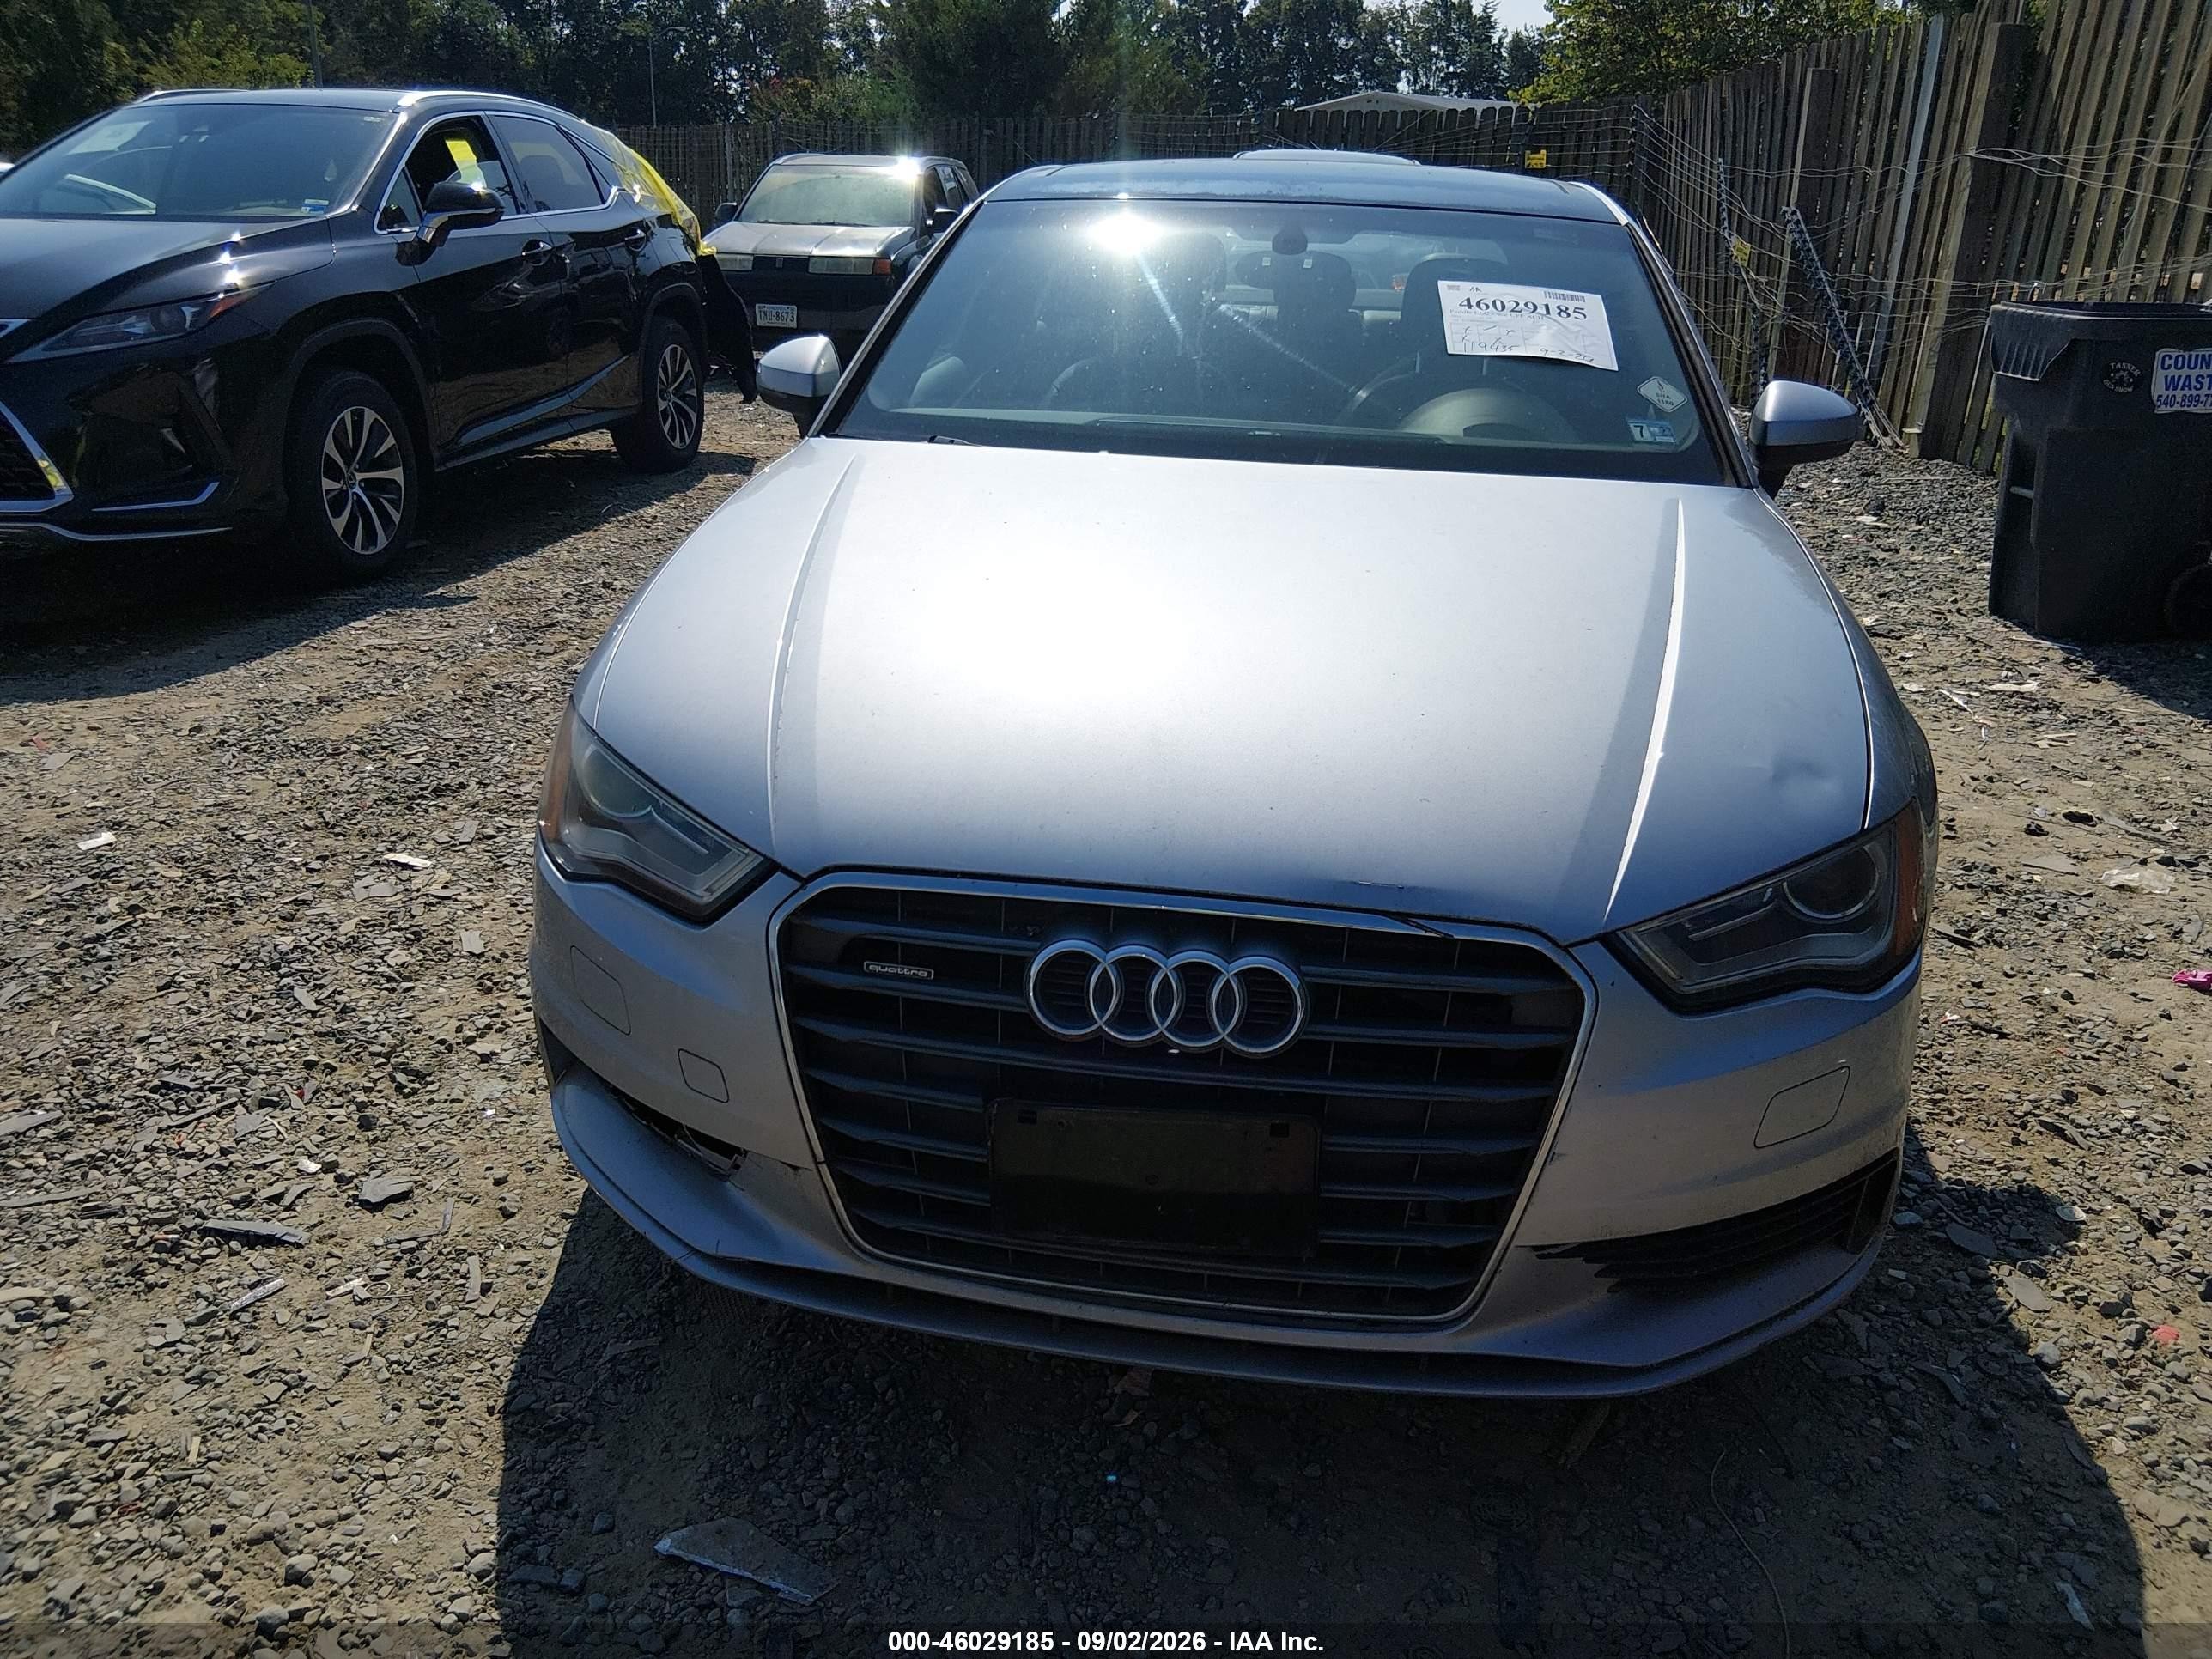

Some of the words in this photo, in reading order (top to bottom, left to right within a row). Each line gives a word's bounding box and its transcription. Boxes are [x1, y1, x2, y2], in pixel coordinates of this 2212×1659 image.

[1458, 296, 1587, 320] 46029185
[2160, 353, 2212, 370] COUN
[869, 964, 928, 977] quattro
